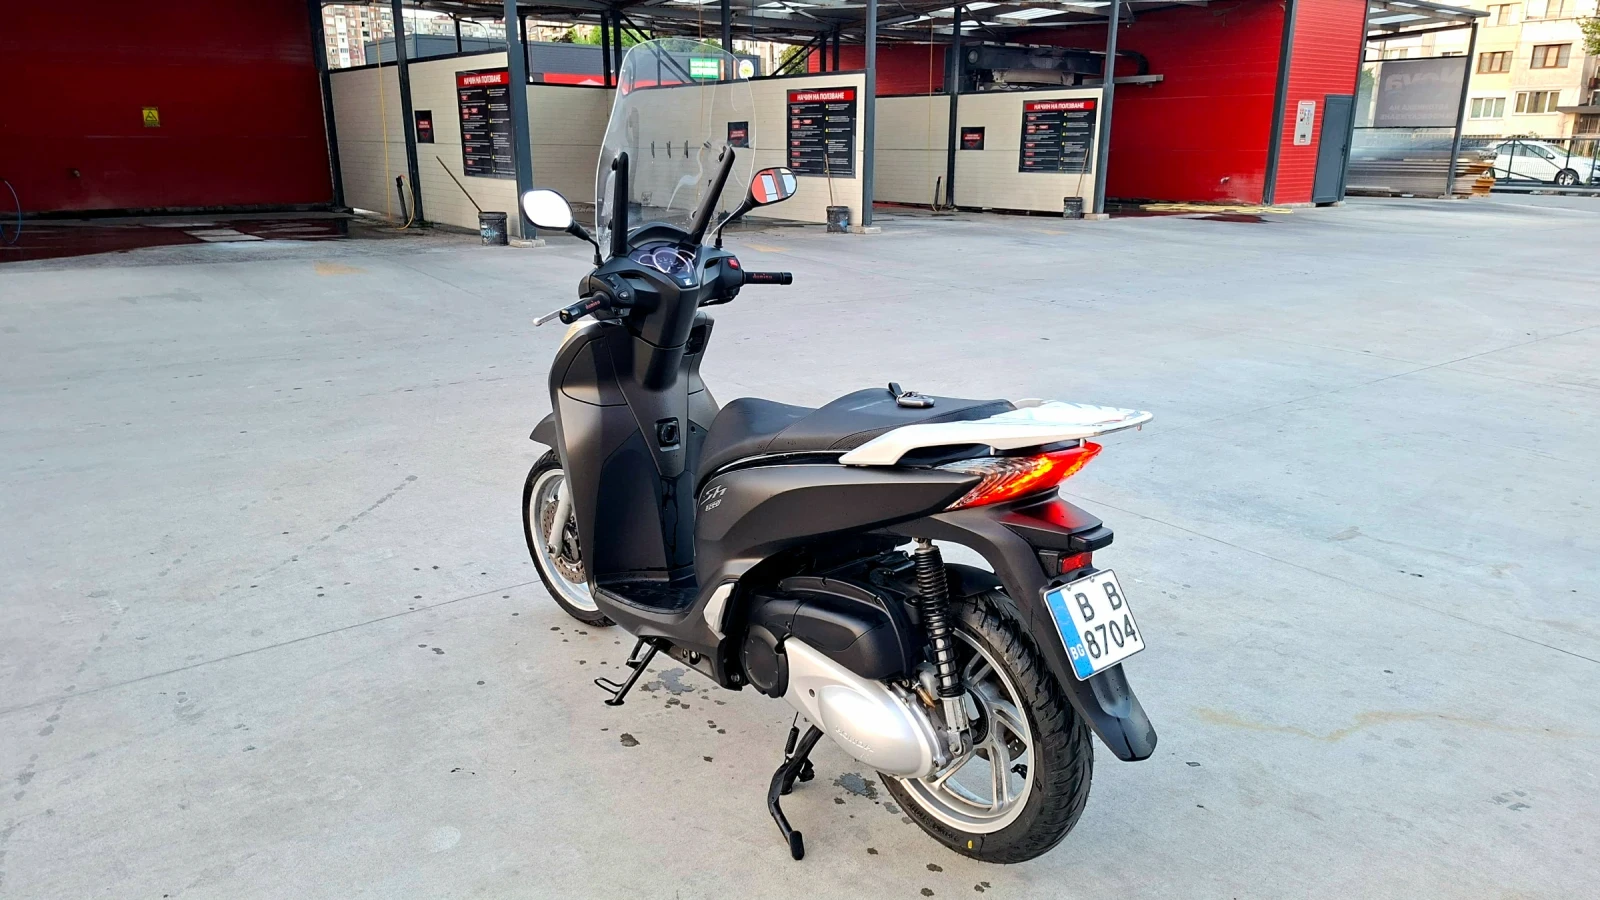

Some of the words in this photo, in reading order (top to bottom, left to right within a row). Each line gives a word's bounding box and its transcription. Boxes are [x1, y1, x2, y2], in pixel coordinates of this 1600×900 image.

[820, 92, 844, 100] ПОЛЗВАНЕ
[1074, 592, 1095, 623] B
[1102, 581, 1122, 611] B
[1084, 613, 1138, 660] 8704
[1069, 643, 1086, 661] BG
